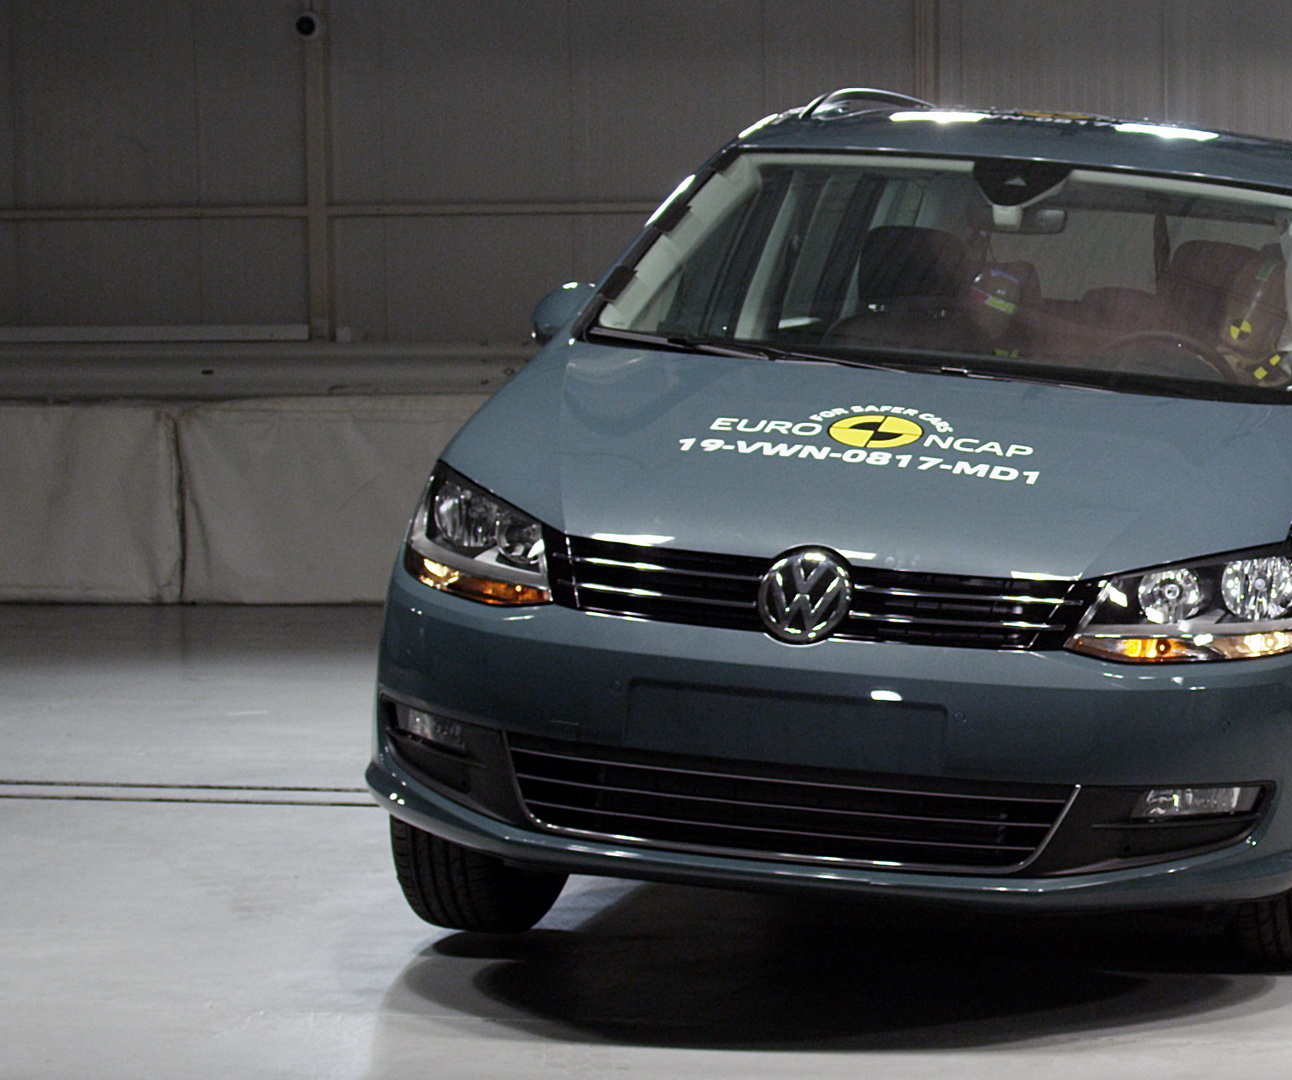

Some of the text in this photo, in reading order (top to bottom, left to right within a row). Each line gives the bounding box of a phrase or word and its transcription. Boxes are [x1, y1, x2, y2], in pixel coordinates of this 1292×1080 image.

[709, 417, 1034, 457] EURO NCAP
[809, 405, 953, 433] FOR SAFER CARS
[678, 437, 1040, 485] 19-VWN-0817-MD1
